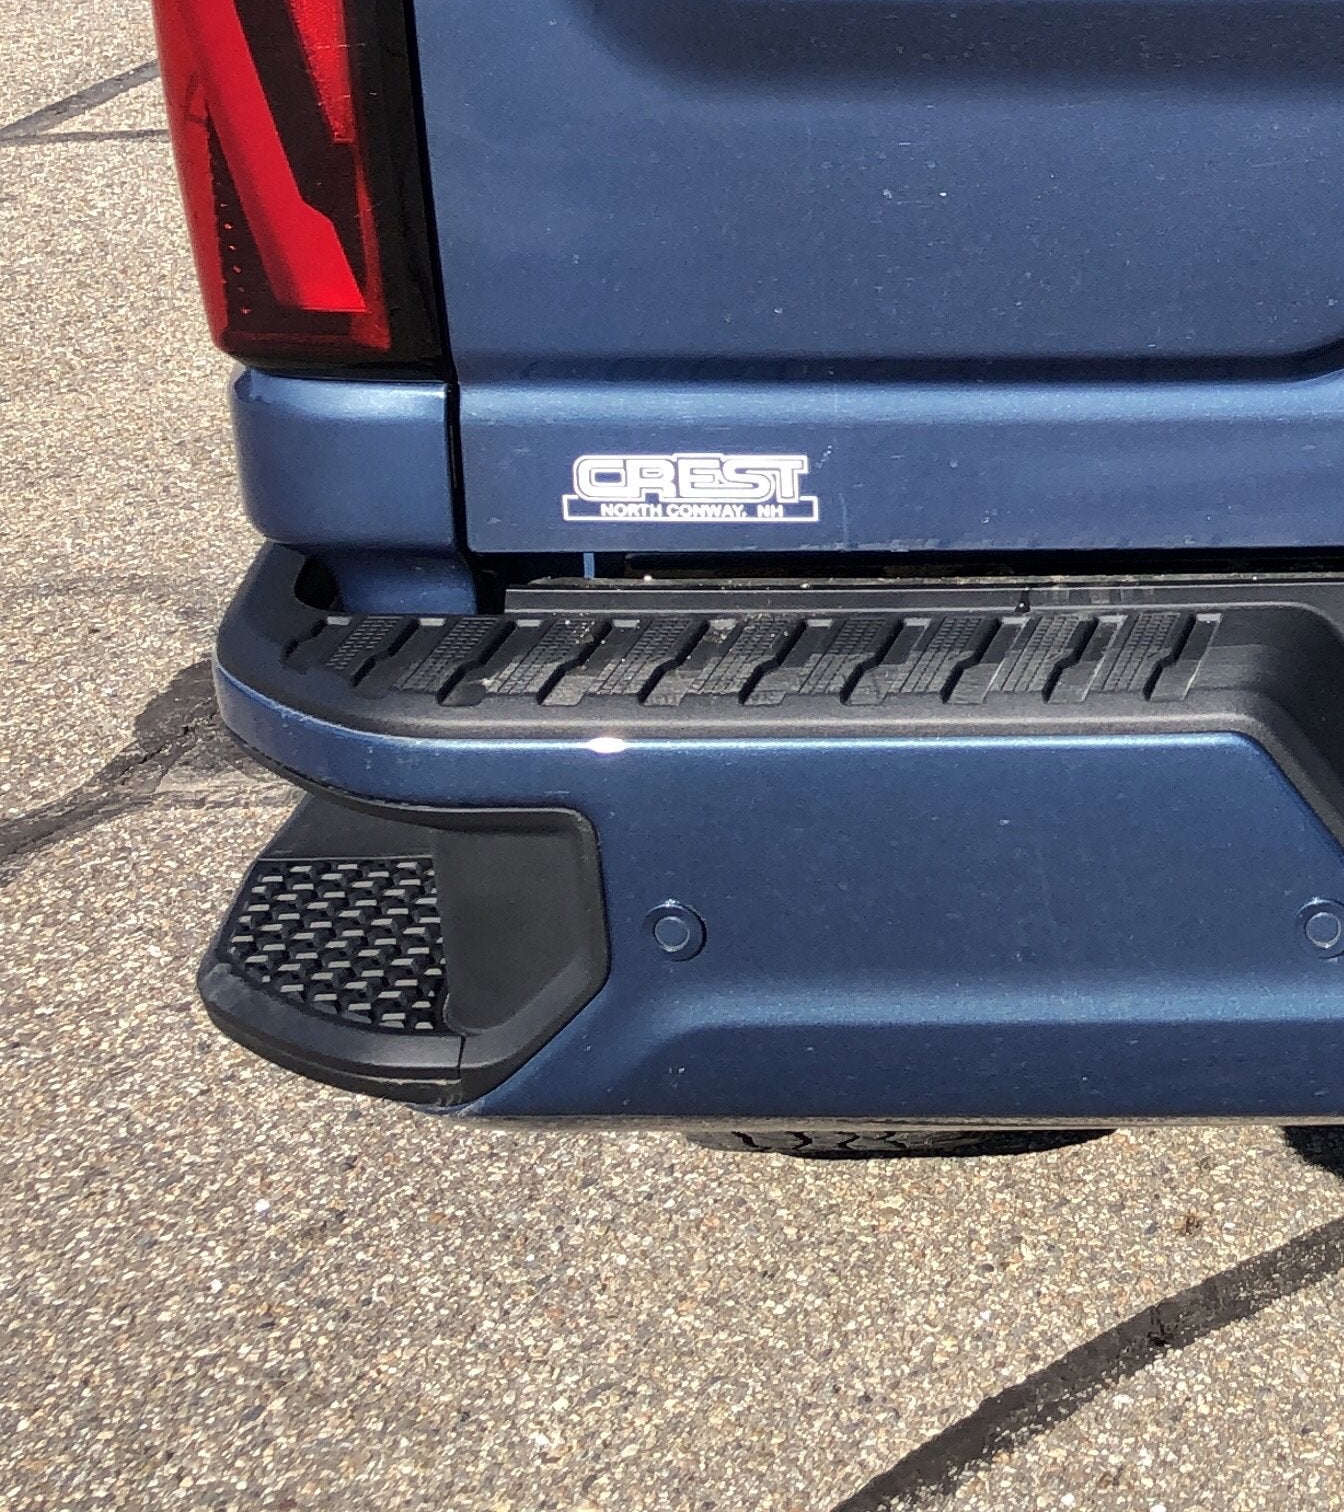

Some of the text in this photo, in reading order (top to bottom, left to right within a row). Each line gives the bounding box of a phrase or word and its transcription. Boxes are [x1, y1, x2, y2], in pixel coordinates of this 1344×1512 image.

[573, 453, 808, 503] CREST
[600, 504, 662, 517] NORTH
[757, 504, 784, 518] NH
